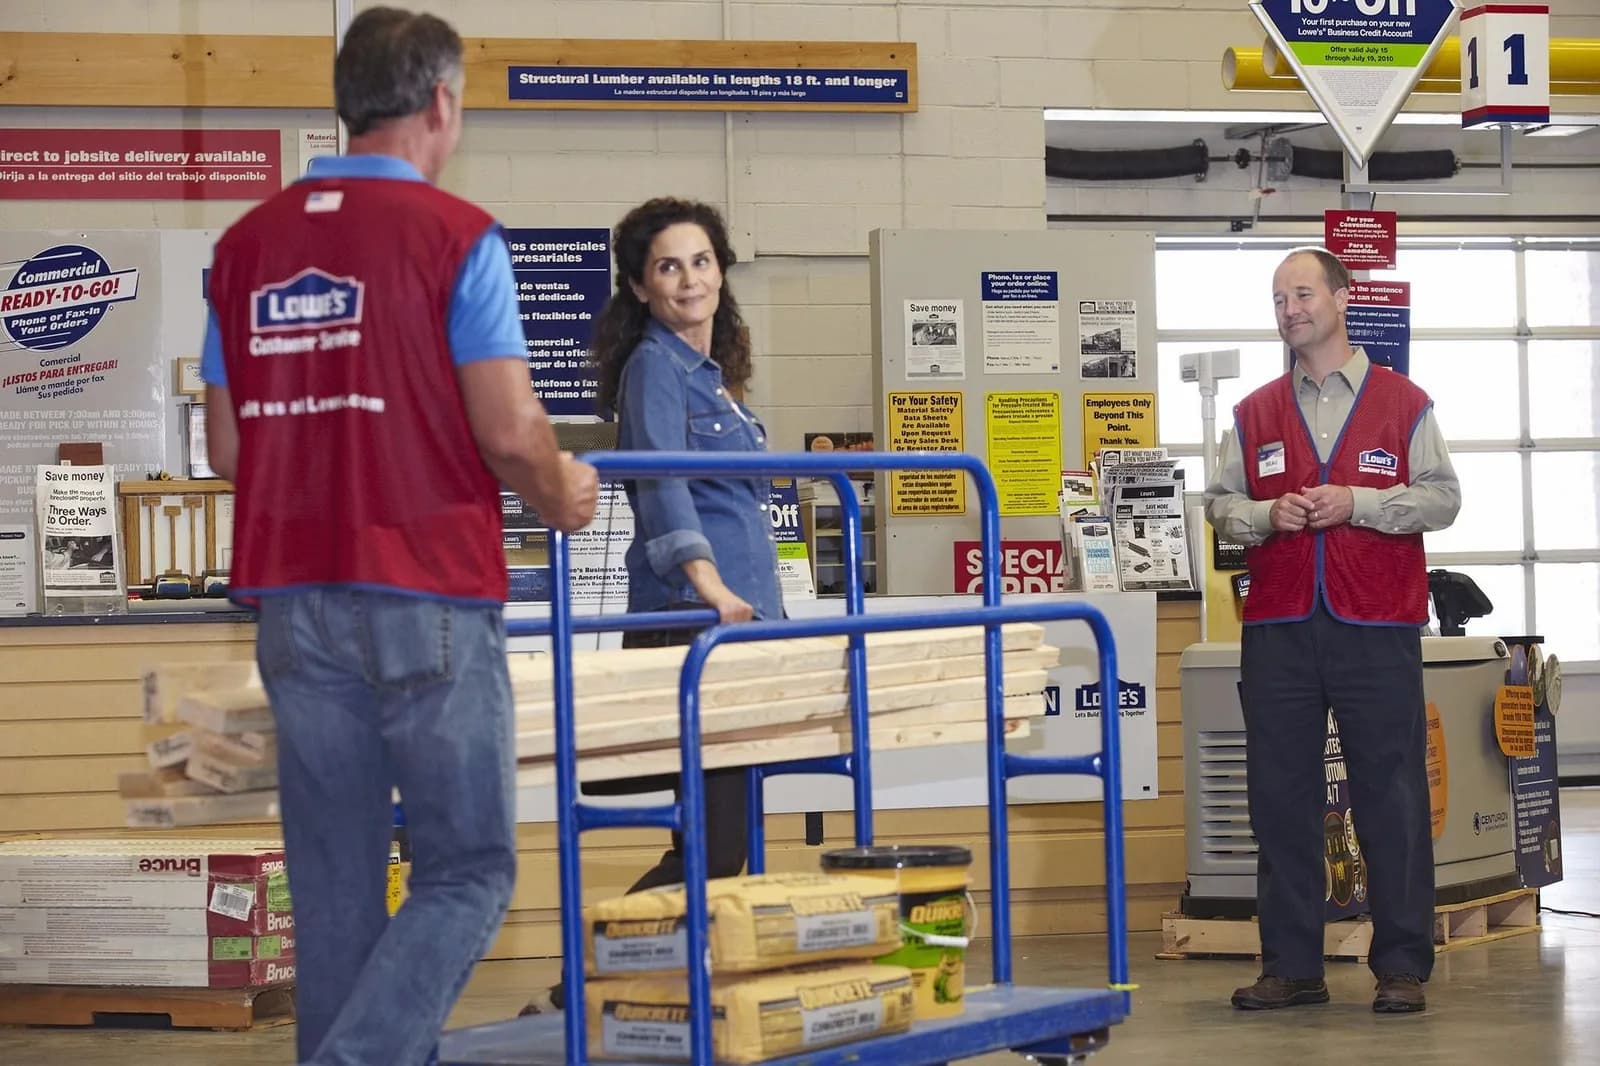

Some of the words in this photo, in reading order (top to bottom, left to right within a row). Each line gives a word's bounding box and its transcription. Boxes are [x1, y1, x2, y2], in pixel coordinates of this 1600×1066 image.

[1301, 18, 1317, 26] Your
[1319, 18, 1334, 26] first
[1335, 19, 1367, 29] purchase
[1379, 21, 1394, 30] your
[1328, 28, 1359, 36] Business
[1360, 29, 1381, 37] Credit
[1382, 29, 1413, 37] Account!
[1330, 46, 1345, 54] Offer
[1349, 46, 1364, 54] valid
[1365, 47, 1379, 55] July
[1325, 54, 1350, 63] through
[1351, 55, 1366, 63] July
[1366, 55, 1376, 63] 19,
[1377, 55, 1394, 63] 2010
[1467, 37, 1479, 89] 1
[1503, 33, 1528, 85] 1
[519, 73, 589, 84] Structural
[593, 74, 644, 85] Lumber
[647, 74, 709, 85] available
[714, 75, 727, 85] in
[730, 75, 781, 87] lengths
[786, 75, 803, 85] 18
[806, 76, 821, 86] ft.
[824, 76, 850, 86] and
[854, 77, 897, 88] longer
[0, 150, 40, 162] irect
[43, 150, 60, 162] to
[64, 150, 120, 165] jobsite
[125, 150, 189, 165] delivery
[195, 150, 267, 163] available
[28, 173, 35, 181] a
[38, 171, 49, 181] la
[52, 172, 95, 183] entrega
[98, 171, 116, 181] del
[119, 171, 143, 181] sitio
[146, 171, 163, 181] del
[166, 171, 206, 183] trabajo
[209, 172, 267, 182] disponible
[510, 241, 526, 252] os
[529, 241, 607, 252] comerciales
[511, 252, 583, 264] presariales
[18, 260, 101, 285] Commercial
[988, 273, 1012, 281] Phone,
[1012, 273, 1023, 281] fax
[1033, 274, 1051, 282] place
[520, 281, 533, 290] de
[535, 282, 570, 291] ventas
[1370, 286, 1404, 294] sentence
[1, 277, 120, 312] READY-TO-GO!
[538, 292, 585, 301] dedicado
[910, 303, 930, 312] Save
[931, 304, 957, 314] money
[11, 315, 48, 328] Phone
[50, 312, 63, 321] or
[65, 307, 101, 319] Fax-In
[532, 312, 577, 321] flexibles
[578, 312, 592, 321] de
[20, 325, 47, 336] Your
[50, 318, 89, 331] Orders
[526, 349, 550, 358] esde
[552, 350, 565, 358] su
[40, 353, 81, 368] Comercial
[553, 360, 567, 369] de
[568, 360, 578, 369] la
[3, 371, 38, 388] ¡LISTOS
[39, 367, 65, 380] PARA
[66, 359, 119, 376] ENTREGAR!
[48, 378, 75, 389] mande
[76, 377, 91, 388] por
[92, 374, 105, 384] fax
[531, 379, 573, 388] teléfono
[582, 379, 599, 388] fax
[38, 390, 51, 400] Sus
[53, 387, 84, 399] pedidos
[544, 389, 580, 399] mismo
[892, 395, 907, 406] For
[908, 395, 929, 406] Your
[930, 395, 959, 408] Safety
[1086, 399, 1130, 409] Employees
[1132, 399, 1152, 409] Only
[1093, 411, 1125, 421] Beyond
[1127, 411, 1144, 419] This
[1107, 423, 1132, 431] Point.
[903, 438, 917, 446] Any
[1099, 437, 1123, 445] Thank
[1124, 437, 1140, 445] You.
[45, 471, 69, 482] Save
[71, 472, 105, 484] money
[53, 488, 69, 496] Make
[49, 504, 76, 516] Three
[78, 506, 108, 518] Ways
[58, 515, 92, 526] Order.
[966, 549, 1065, 575] SECI
[1043, 690, 1057, 712] N
[1082, 689, 1139, 707] LOE'S
[138, 857, 201, 872] Bruce
[281, 936, 296, 949] Bru
